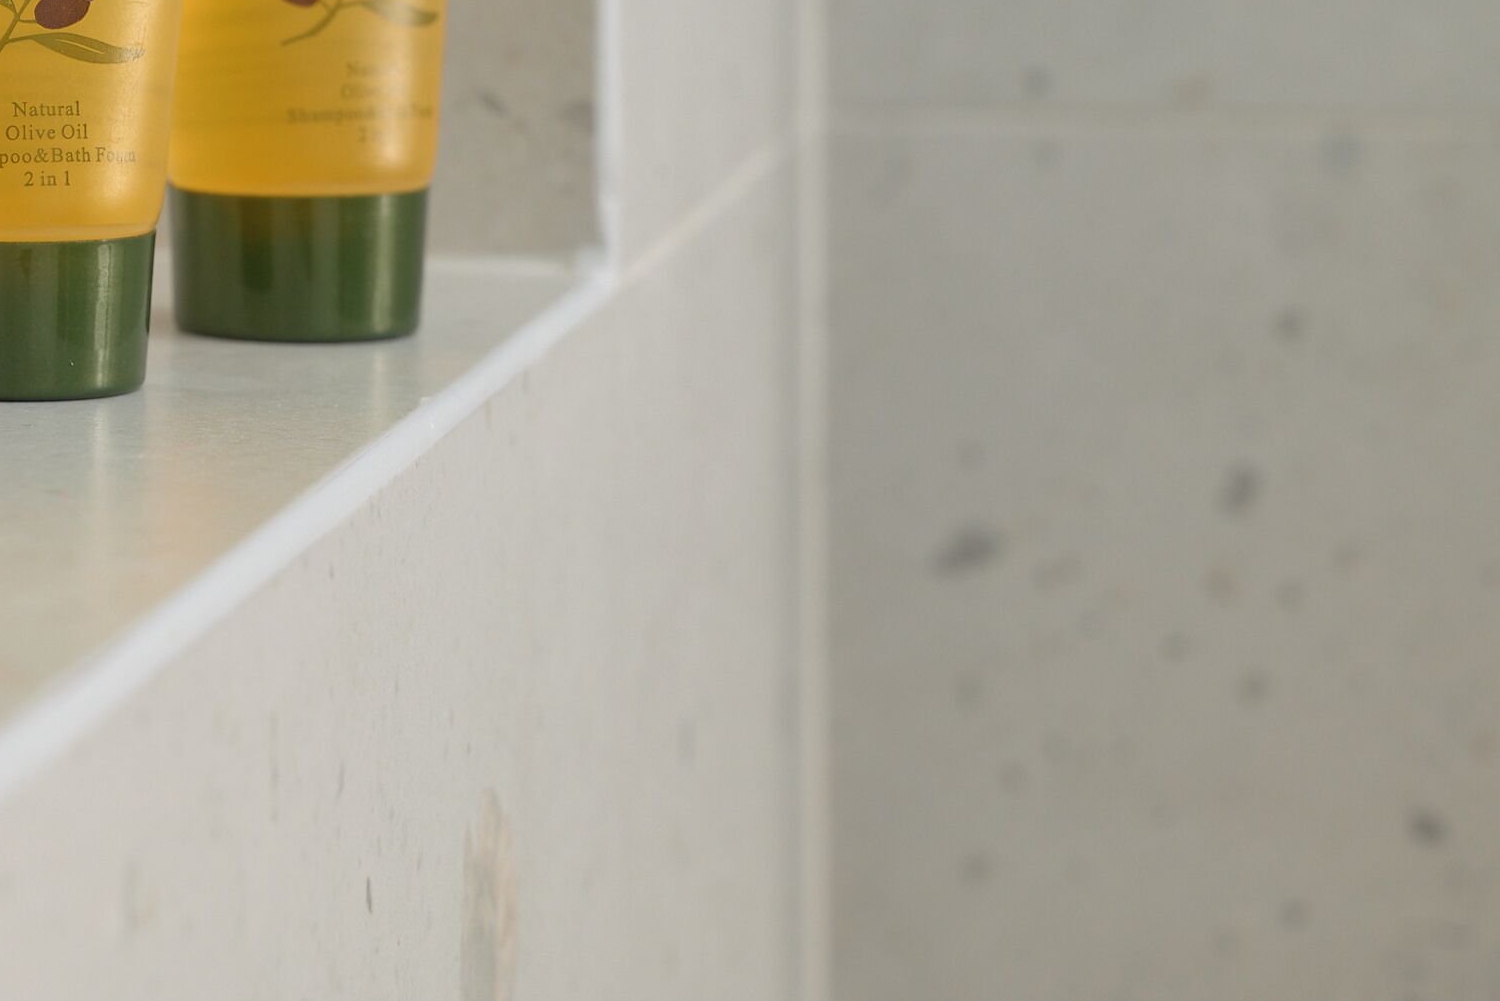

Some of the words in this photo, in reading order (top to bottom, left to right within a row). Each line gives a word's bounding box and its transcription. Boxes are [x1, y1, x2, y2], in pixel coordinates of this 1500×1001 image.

[12, 100, 80, 117] Natural
[5, 124, 56, 141] Olive
[61, 123, 88, 140] Oil
[95, 146, 136, 164] Fom
[24, 171, 34, 187] 2
[40, 170, 57, 186] in
[64, 170, 71, 186] 1
